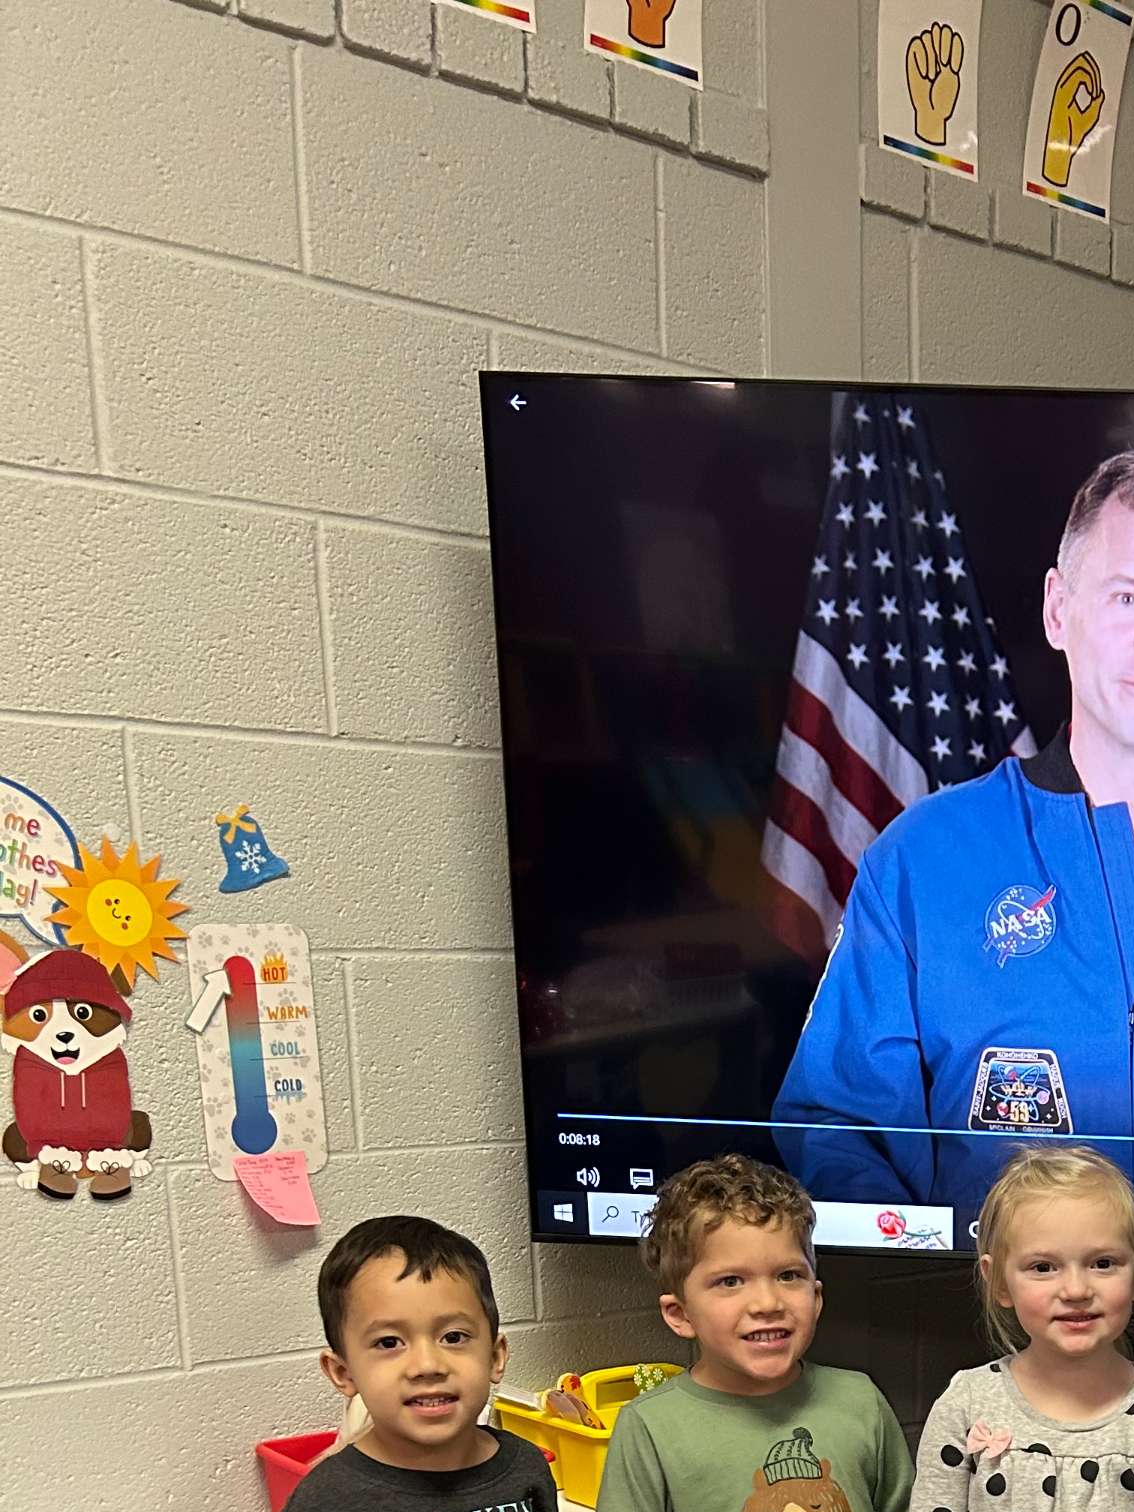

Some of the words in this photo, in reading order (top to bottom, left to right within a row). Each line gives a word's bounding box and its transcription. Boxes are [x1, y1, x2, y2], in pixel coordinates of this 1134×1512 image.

[1055, 2, 1081, 47] O
[4, 812, 40, 836] me
[0, 871, 38, 907] ay!
[990, 906, 1052, 938] NASA
[262, 967, 287, 982] HOT
[266, 1005, 310, 1021] WARM
[270, 1041, 301, 1057] COOL
[274, 1078, 303, 1093] COLD
[1010, 1101, 1030, 1122] 59
[558, 1132, 601, 1146] 0:08:18
